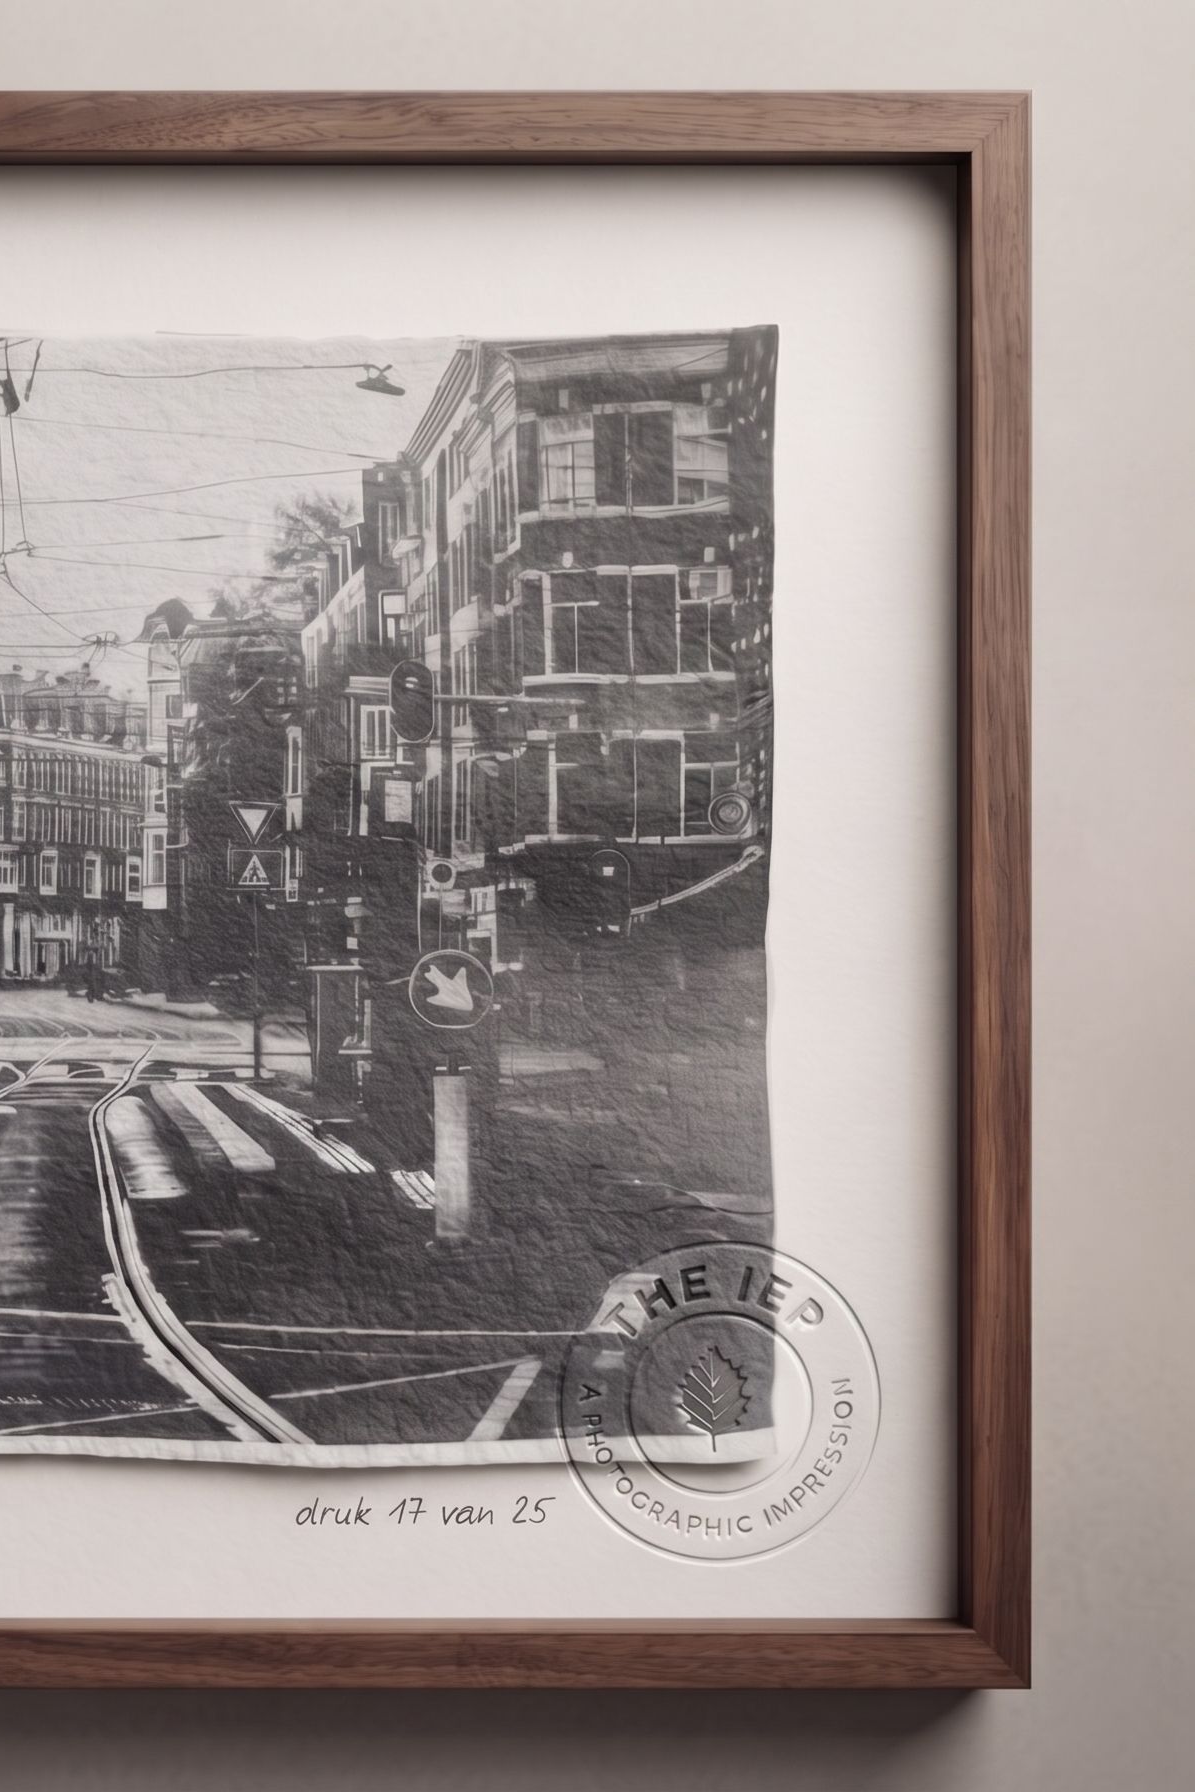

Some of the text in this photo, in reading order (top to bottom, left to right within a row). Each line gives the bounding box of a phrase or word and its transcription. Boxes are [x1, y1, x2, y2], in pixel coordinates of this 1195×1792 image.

[600, 1265, 824, 1337] THE IEP
[579, 1378, 853, 1535] A PHOTOGRAPHIC IMPRESSION
[295, 1495, 557, 1525] druk 17 van 25
